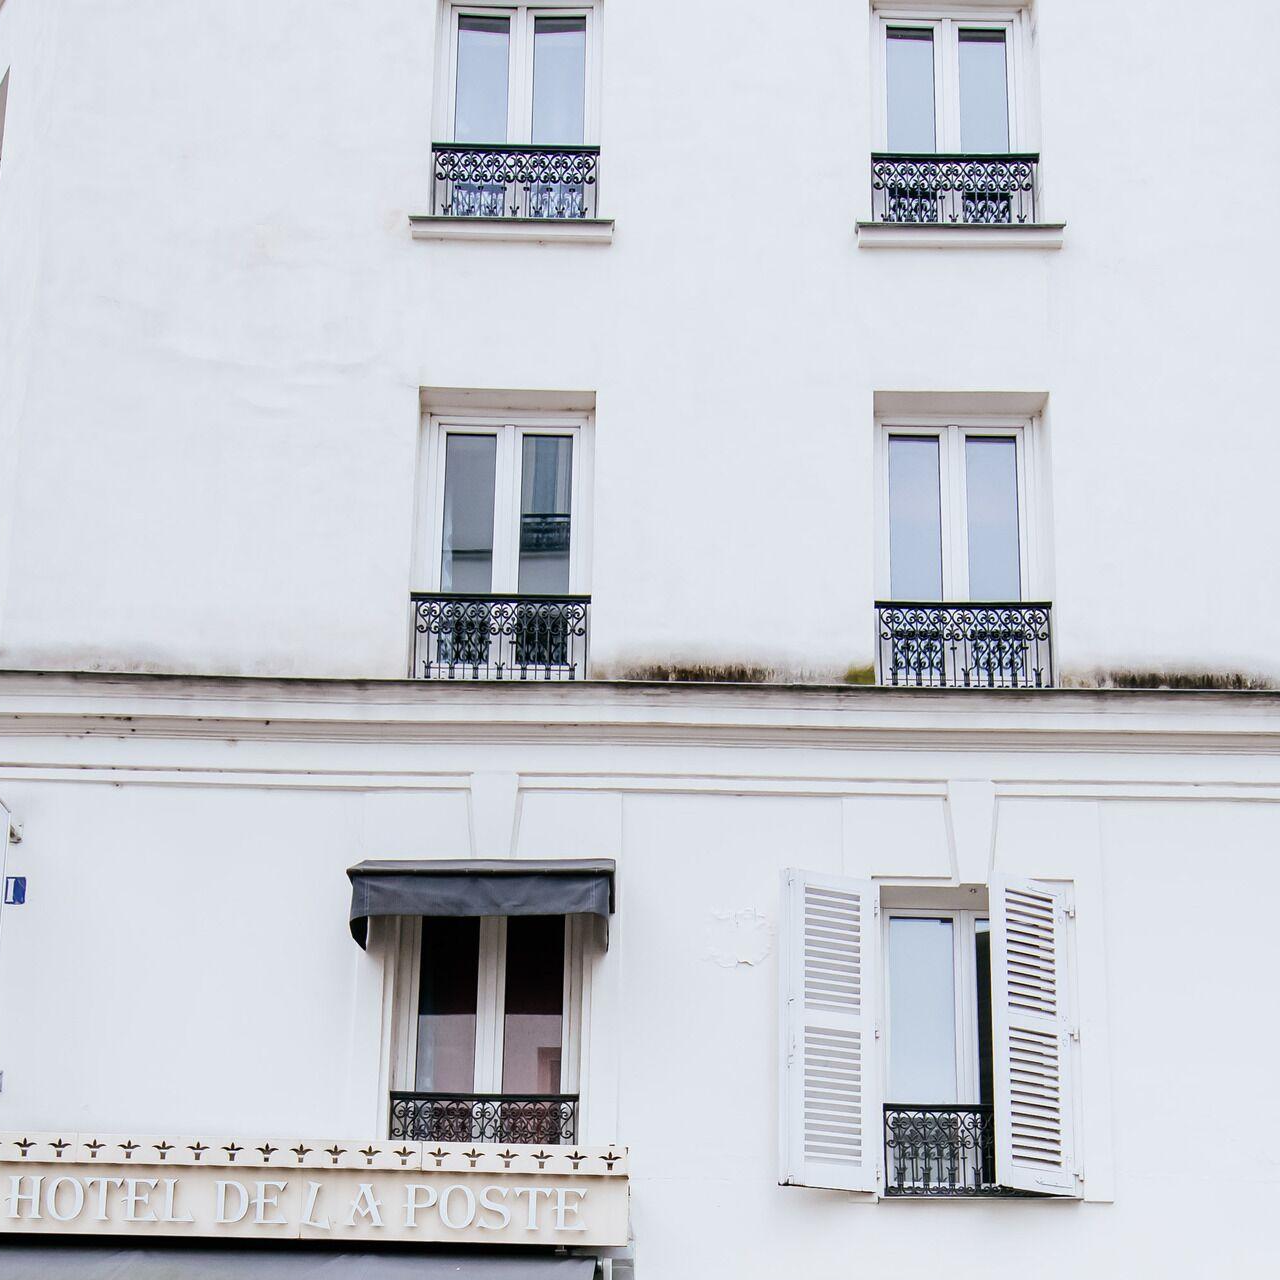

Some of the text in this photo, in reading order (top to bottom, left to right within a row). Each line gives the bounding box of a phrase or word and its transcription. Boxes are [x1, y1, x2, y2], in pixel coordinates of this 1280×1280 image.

[4, 1175, 589, 1232] HOTEL DE LA POSTE
